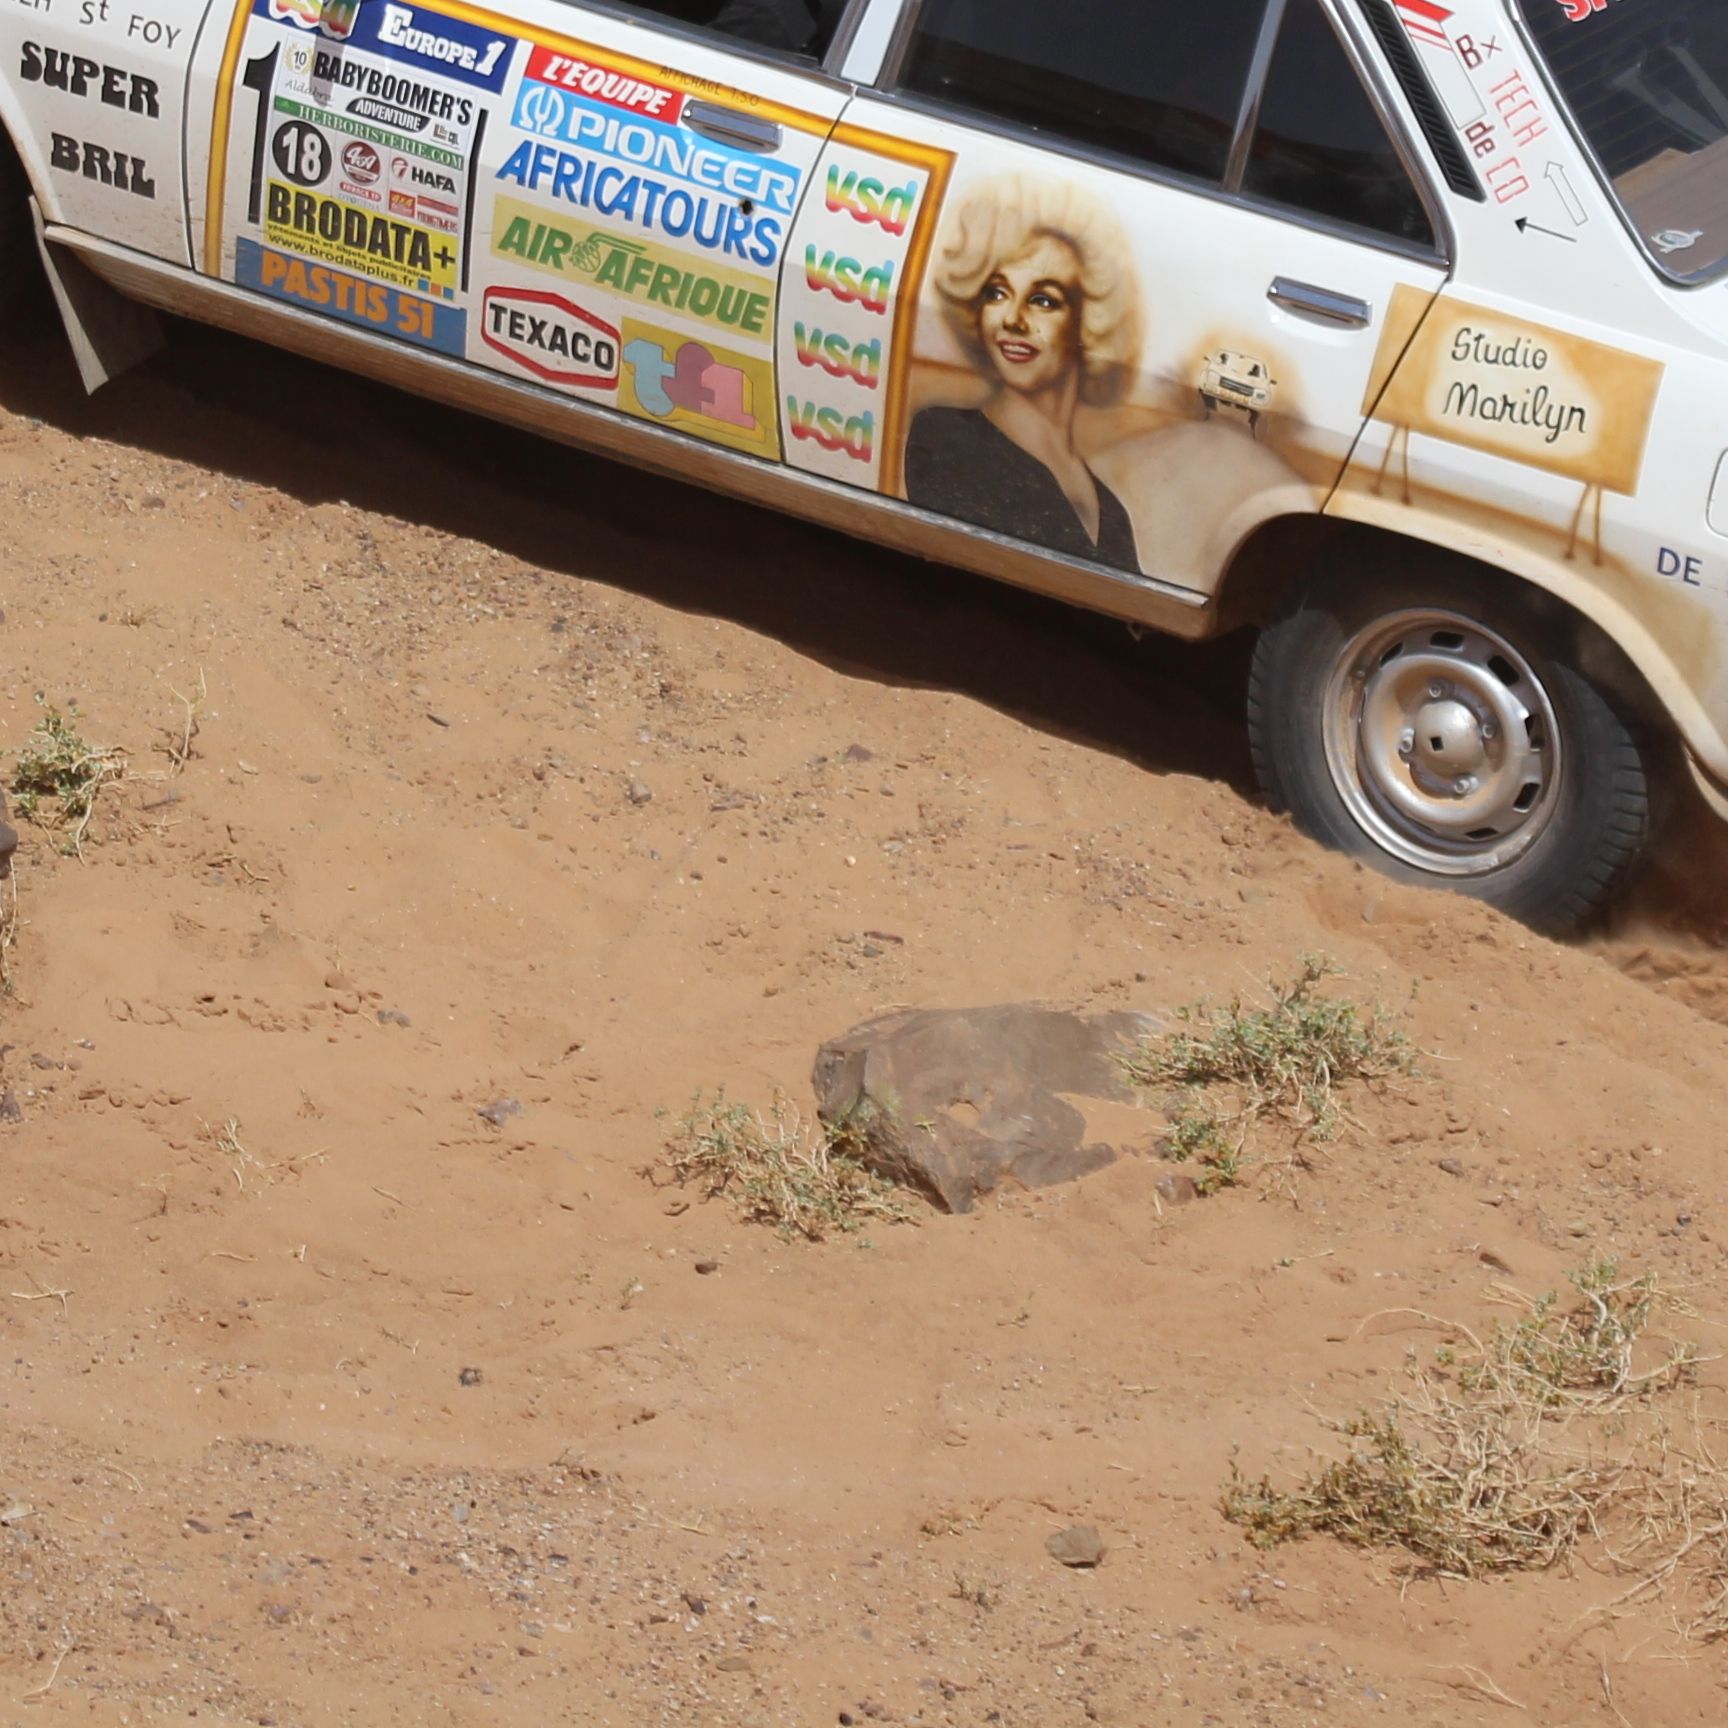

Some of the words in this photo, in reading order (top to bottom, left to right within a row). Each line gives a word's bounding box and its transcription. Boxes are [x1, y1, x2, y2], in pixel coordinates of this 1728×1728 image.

[127, 15, 183, 50] FOY
[293, 49, 308, 66] 10
[20, 40, 161, 119] SUPER
[313, 49, 473, 126] BABYBOOMER'S
[298, 103, 465, 171] HERBORISTERIE.COM
[355, 97, 422, 131] ADVENTURE
[51, 132, 157, 200] BRIL
[281, 127, 323, 182] 18
[411, 166, 457, 195] HAFA
[567, 109, 796, 212] PIONEER
[268, 182, 456, 271] BRODATA+
[494, 139, 784, 268] AFRICATOURS
[261, 248, 388, 323] PASTIS
[397, 294, 435, 340] 51
[268, 235, 415, 288] www.brodataplus.fr
[336, 244, 367, 263] objets
[368, 252, 432, 280] publicitaires
[496, 216, 574, 270] AIR
[594, 246, 772, 334] AFRIQUE
[488, 302, 616, 374] TEXACO
[1449, 325, 1550, 373] Studio
[1440, 379, 1588, 446] Marilyn
[1657, 546, 1703, 586] DE
